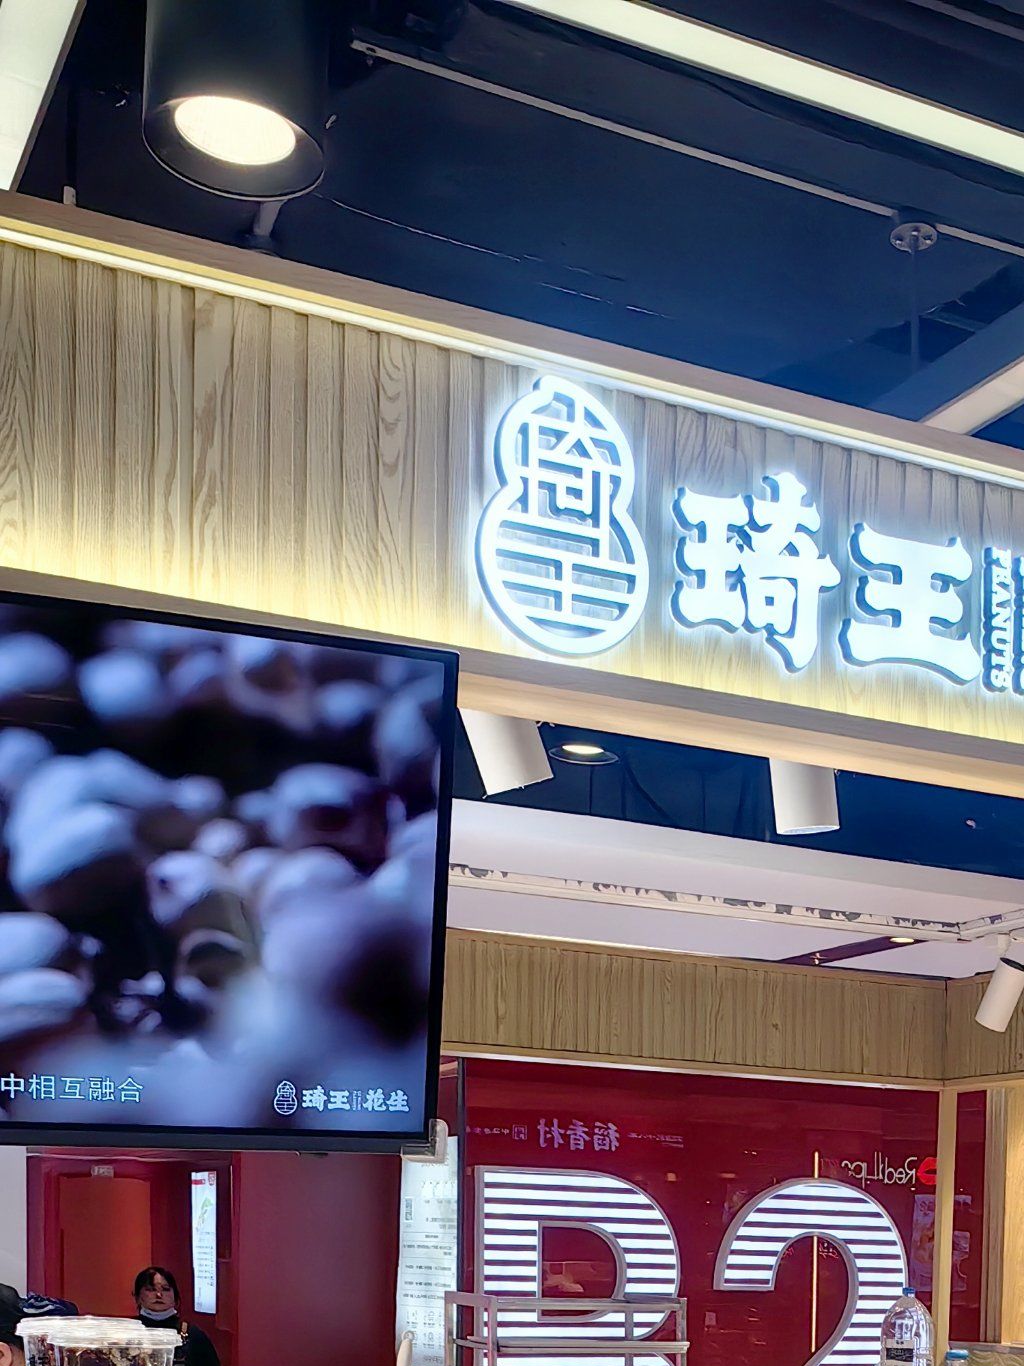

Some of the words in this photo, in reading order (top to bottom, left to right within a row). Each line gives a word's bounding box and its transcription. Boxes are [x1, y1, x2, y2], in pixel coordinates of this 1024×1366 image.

[986, 546, 1012, 691] PEANUTS
[1, 1073, 143, 1102] 中相互融合
[302, 1085, 410, 1112] 琦王花生
